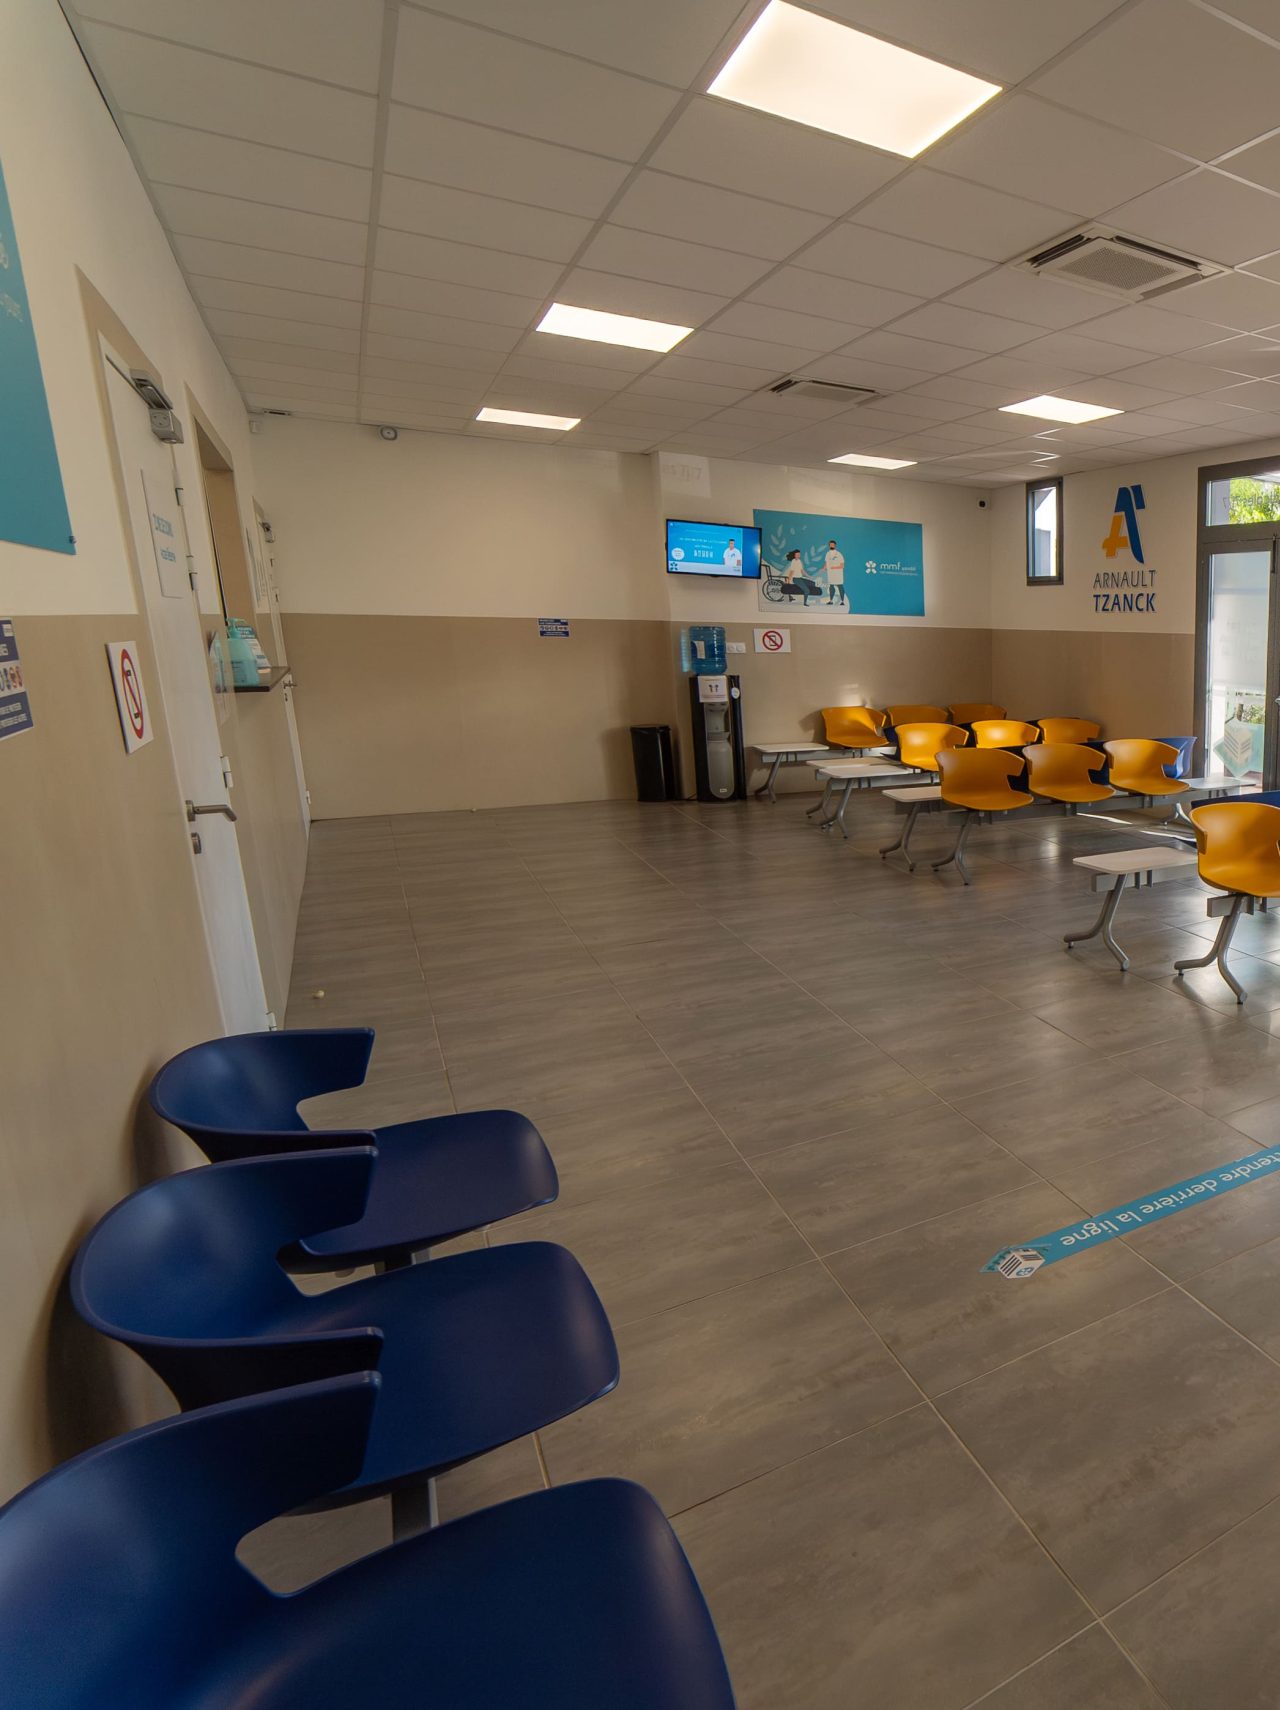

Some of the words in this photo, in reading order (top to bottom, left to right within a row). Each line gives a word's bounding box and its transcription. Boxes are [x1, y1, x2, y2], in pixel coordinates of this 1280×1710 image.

[1093, 570, 1156, 588] ARNAULT
[1093, 593, 1155, 611] TZANCK
[1139, 1179, 1218, 1214] derrière
[1116, 1211, 1142, 1222] la
[1059, 1220, 1119, 1246] ligne
